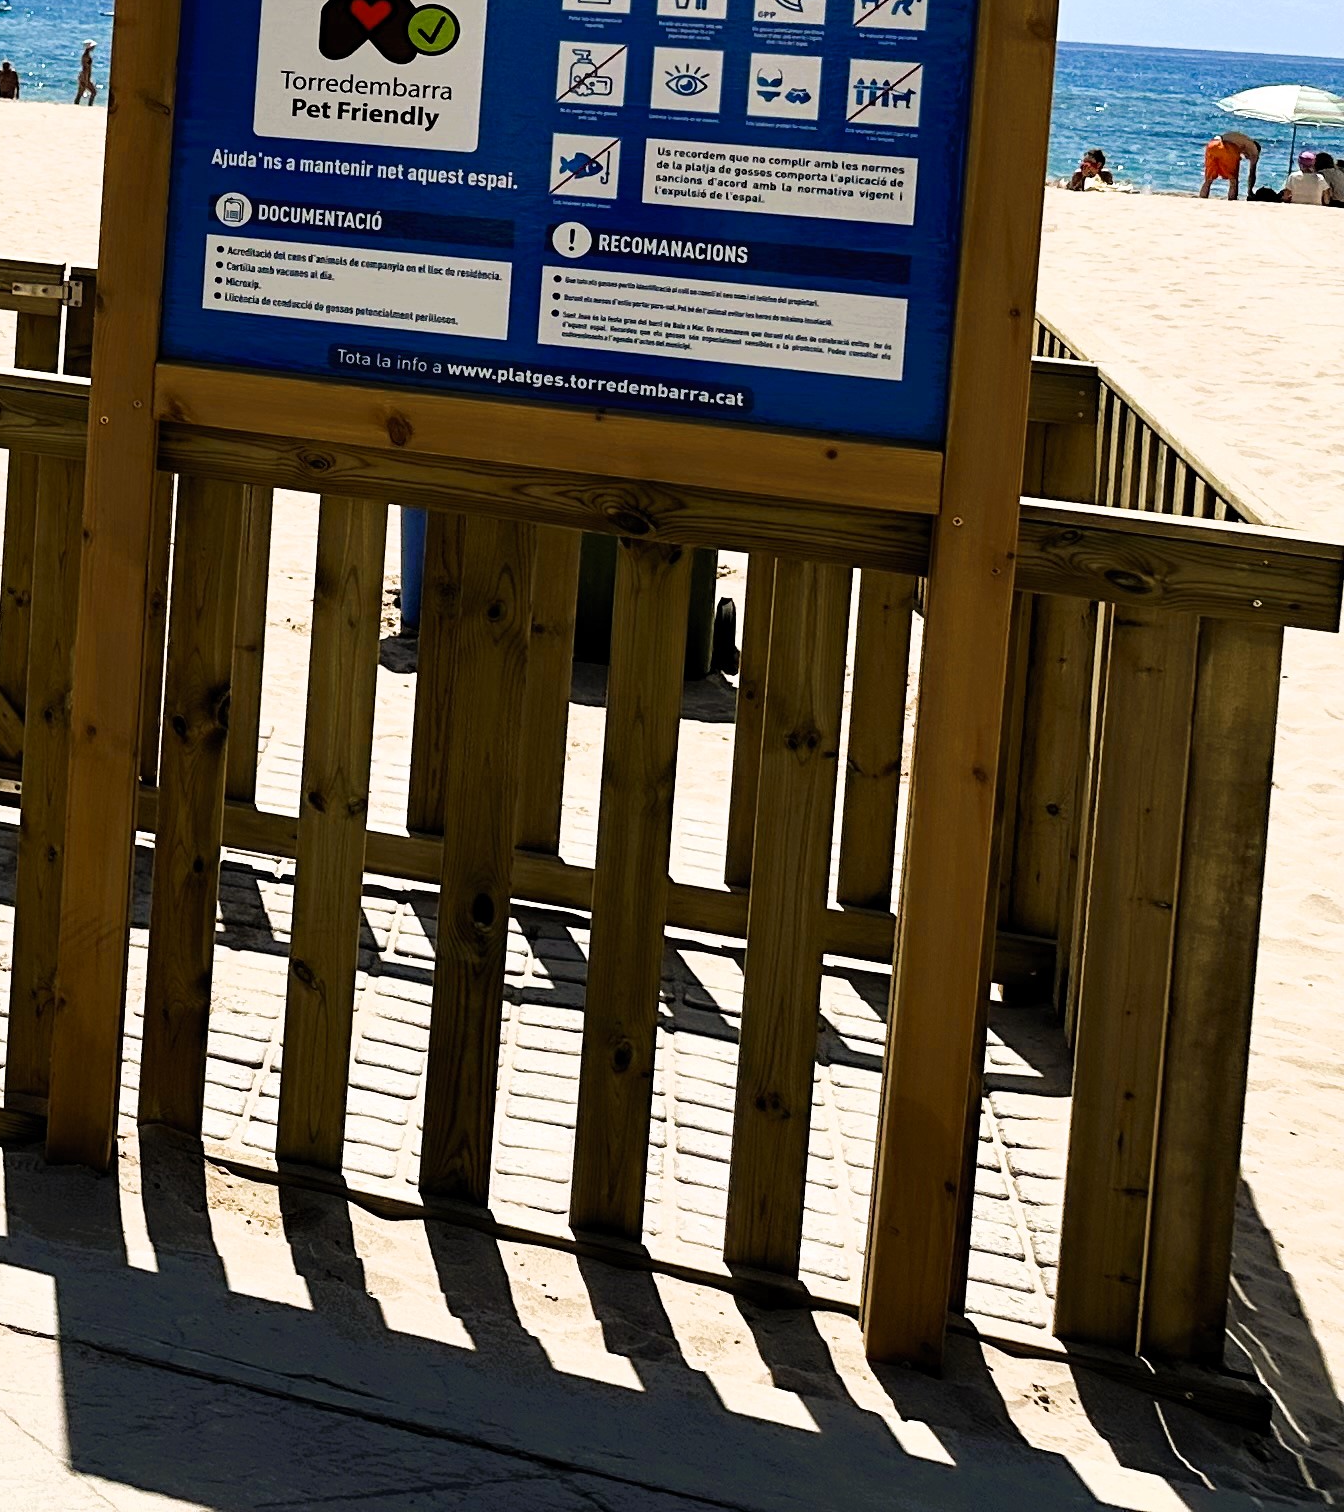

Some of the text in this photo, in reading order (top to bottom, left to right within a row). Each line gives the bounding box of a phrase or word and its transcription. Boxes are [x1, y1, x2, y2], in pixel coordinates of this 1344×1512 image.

[281, 70, 452, 100] Torredembarra
[291, 98, 440, 132] Pet Friendly
[211, 148, 518, 190] Ajuda'ns a mantenir net aquest espai.
[657, 160, 904, 187] de la platja de gossos comporta l'aplicació de
[658, 147, 905, 174] Us recordem que no complir amb les normes
[654, 185, 707, 198] l'expulsió
[710, 191, 723, 199] de
[655, 174, 702, 184] sancions
[707, 177, 747, 188] d'acord
[752, 182, 776, 191] amb
[782, 183, 792, 192] la
[797, 186, 854, 197] normativa
[859, 189, 894, 200] vigent
[258, 204, 383, 231] DOCUMENTACIÓ
[227, 246, 272, 259] Acreditació
[349, 258, 359, 267] de
[418, 264, 426, 273] el
[598, 234, 749, 264] RECOMANACIONS
[257, 266, 274, 275] amb
[337, 348, 744, 407] Tota la info a www.platges.torredembarra.cat
